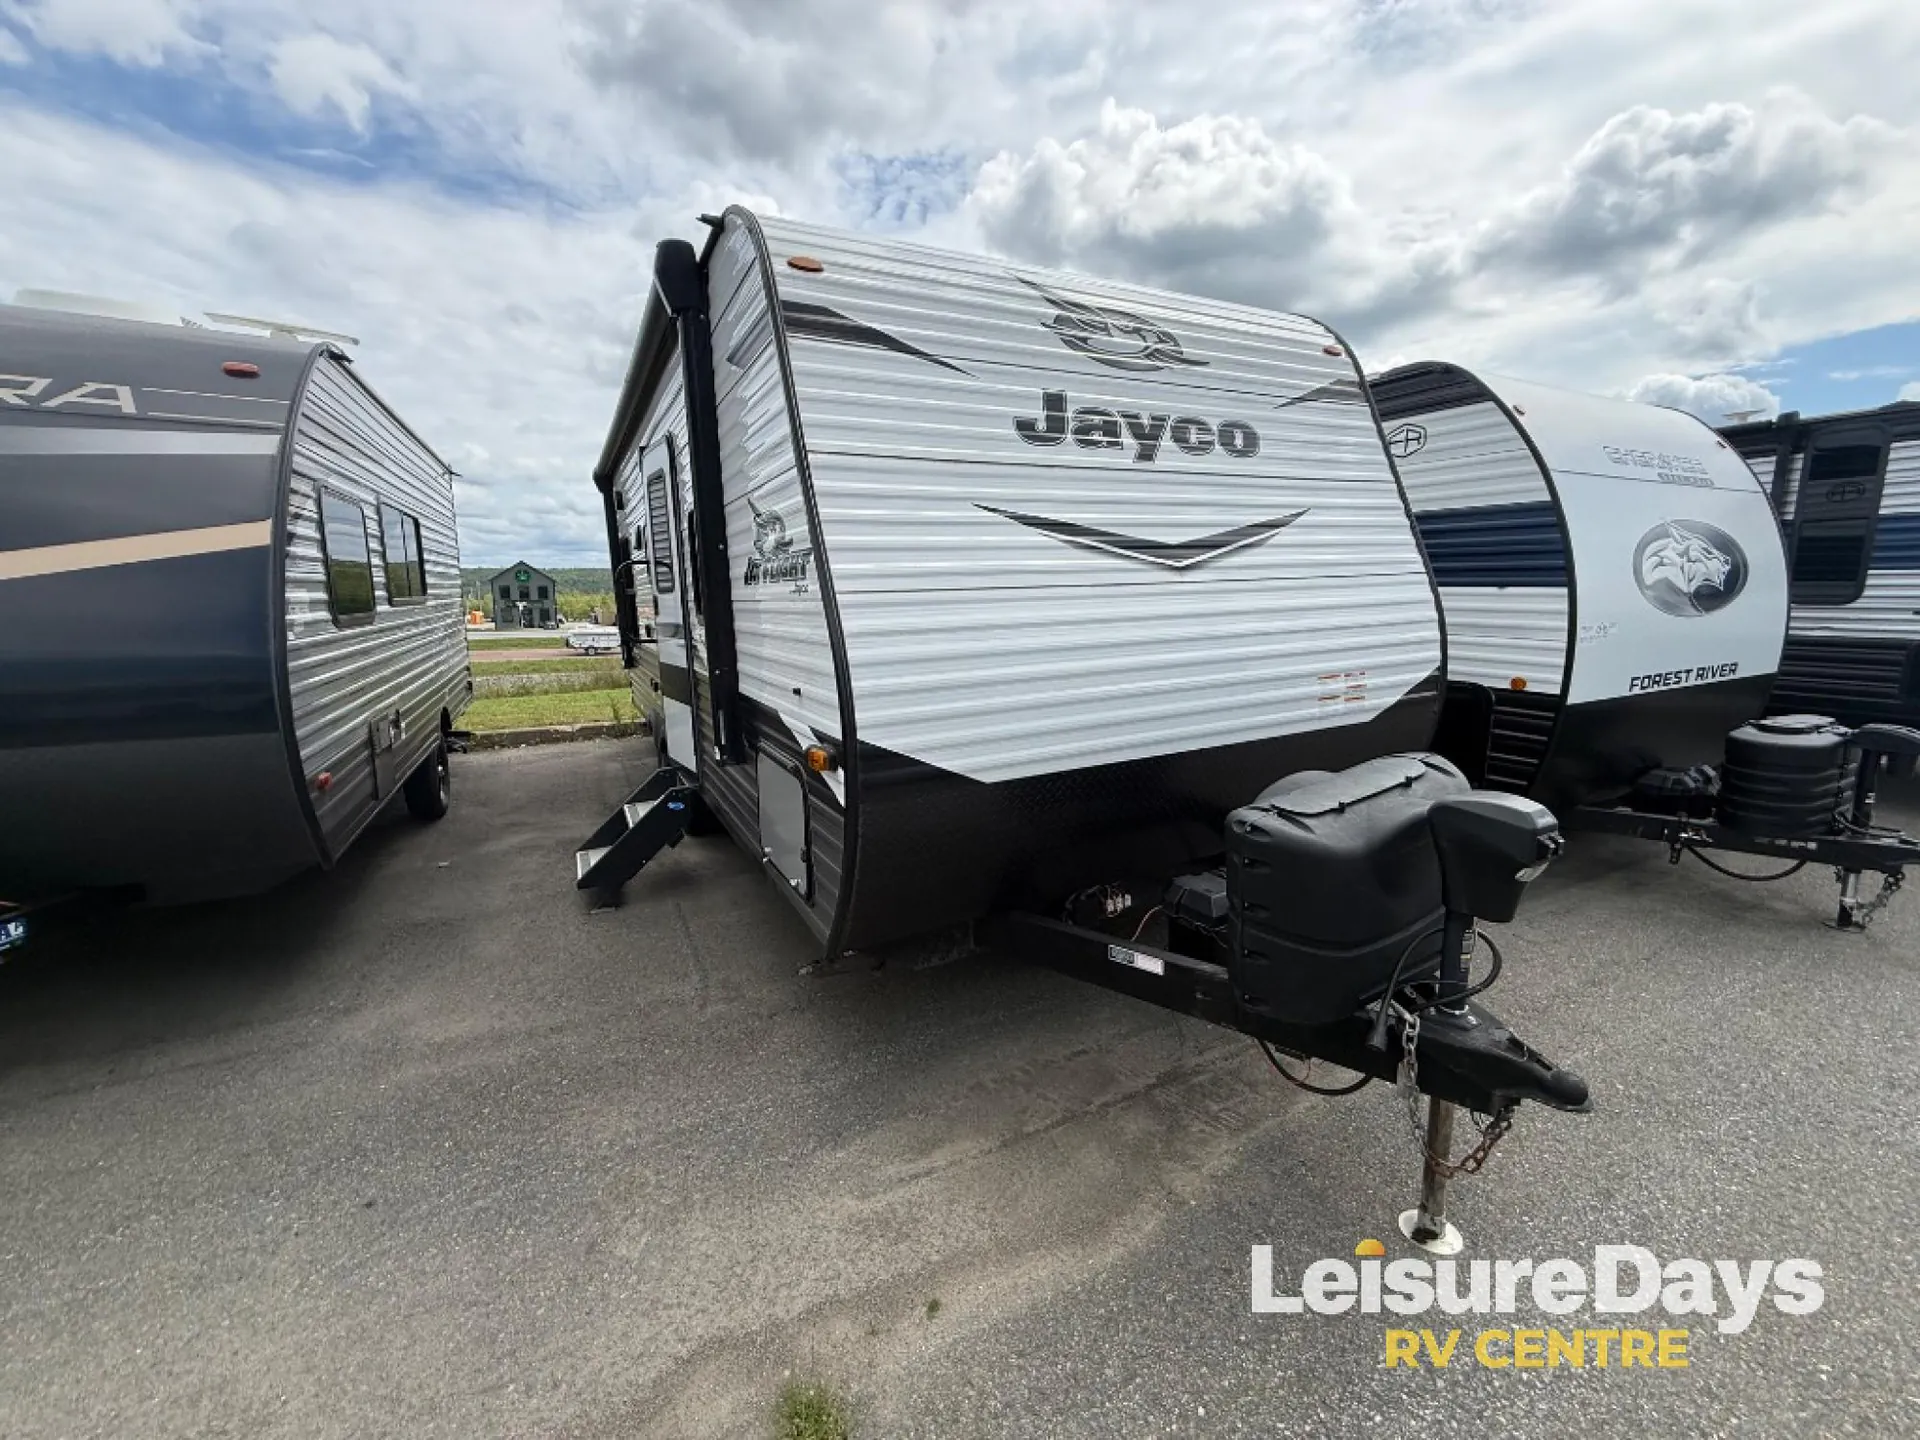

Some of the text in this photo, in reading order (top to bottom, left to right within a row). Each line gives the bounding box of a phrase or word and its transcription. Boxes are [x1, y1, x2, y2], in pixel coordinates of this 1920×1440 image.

[1012, 388, 1261, 464] Jayco
[1628, 661, 1739, 692] FOREST RIVER
